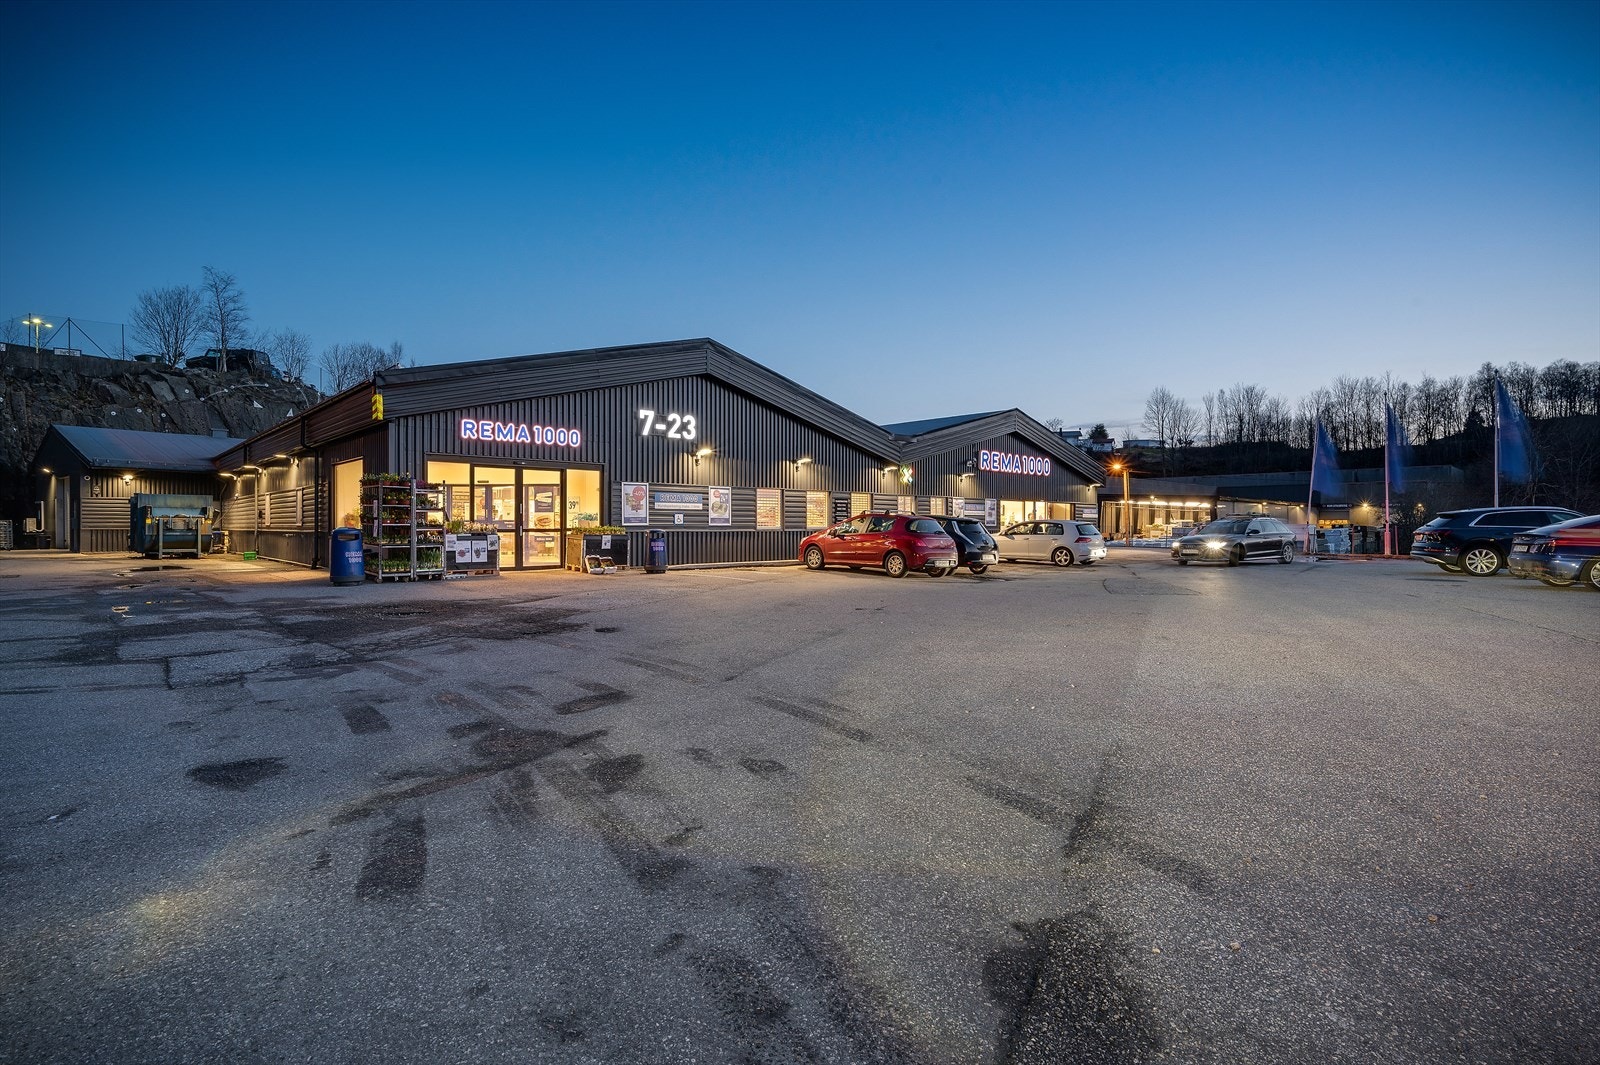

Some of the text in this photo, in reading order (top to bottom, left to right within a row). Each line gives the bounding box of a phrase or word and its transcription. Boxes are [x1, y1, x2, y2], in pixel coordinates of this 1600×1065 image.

[461, 419, 581, 447] REMA 1000
[639, 409, 696, 440] 7-23
[980, 449, 1051, 476] REMA 1000
[660, 493, 698, 503] REMA 1000
